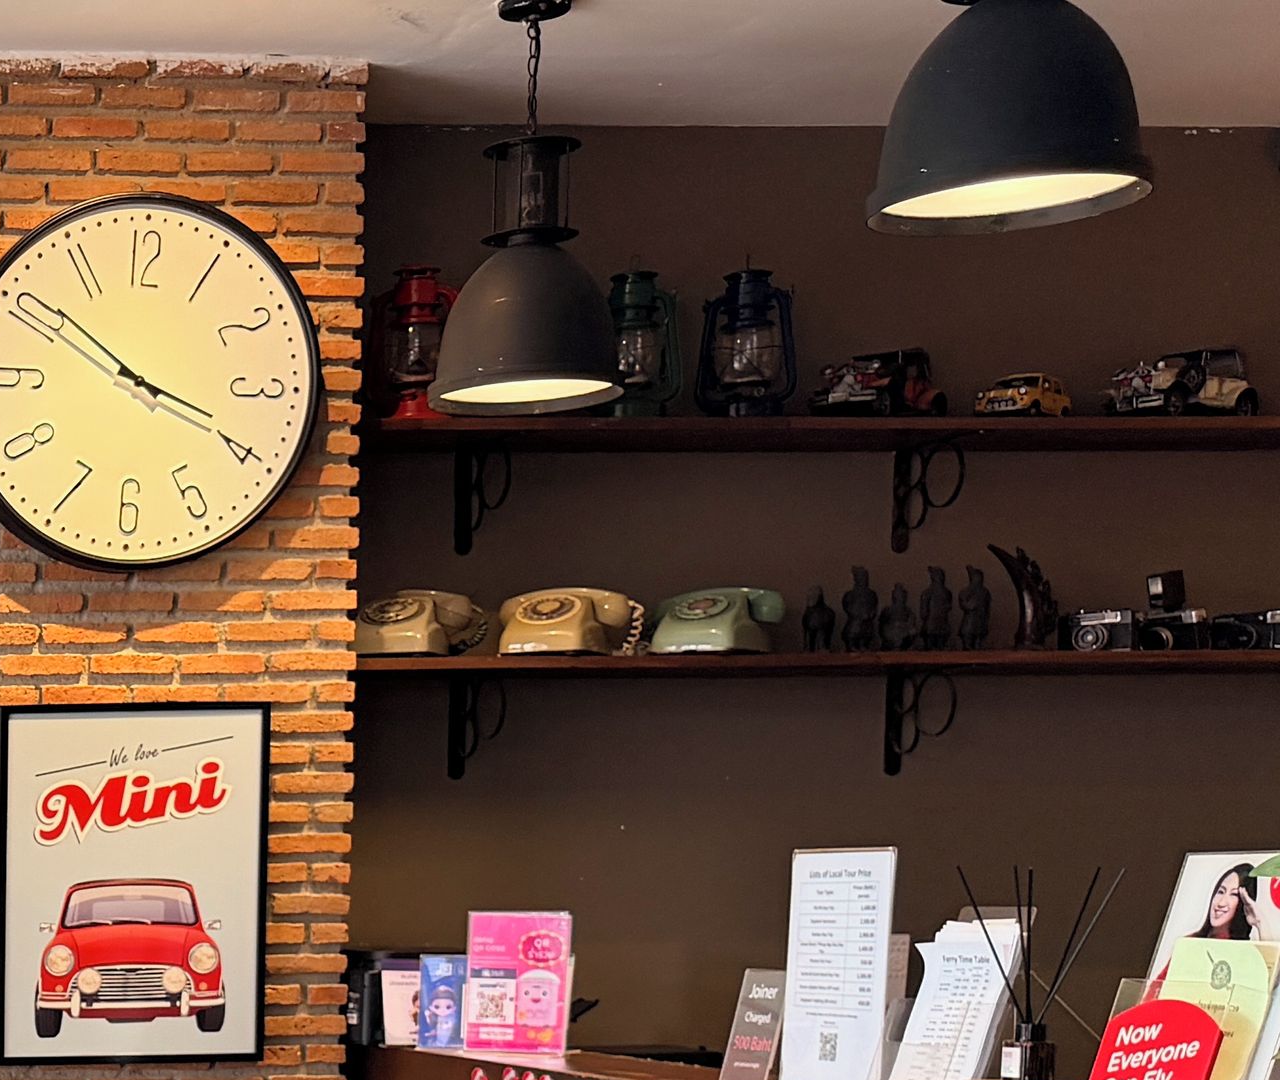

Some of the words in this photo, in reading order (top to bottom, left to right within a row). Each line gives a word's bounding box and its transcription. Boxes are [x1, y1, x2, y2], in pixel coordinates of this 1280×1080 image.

[67, 243, 102, 300] 11
[131, 229, 161, 288] 12
[218, 307, 271, 347] 2
[230, 377, 284, 398] 3
[4, 422, 54, 459] 8
[217, 430, 262, 464] 4
[53, 460, 93, 513] 7
[171, 464, 207, 518] 5
[119, 478, 140, 534] 6
[109, 749, 129, 768] We
[137, 743, 159, 761] love
[37, 759, 230, 843] Mini
[823, 870, 828, 878] of
[829, 870, 842, 878] Local
[844, 869, 856, 877] Tour
[858, 869, 871, 877] Price
[959, 954, 973, 964] Time
[975, 955, 989, 964] Table
[749, 984, 778, 999] Joiner
[744, 1012, 772, 1025] Charged
[1115, 1023, 1163, 1047] Now
[734, 1035, 749, 1050] 500
[751, 1035, 772, 1051] Baht
[1107, 1040, 1200, 1073] Everyone
